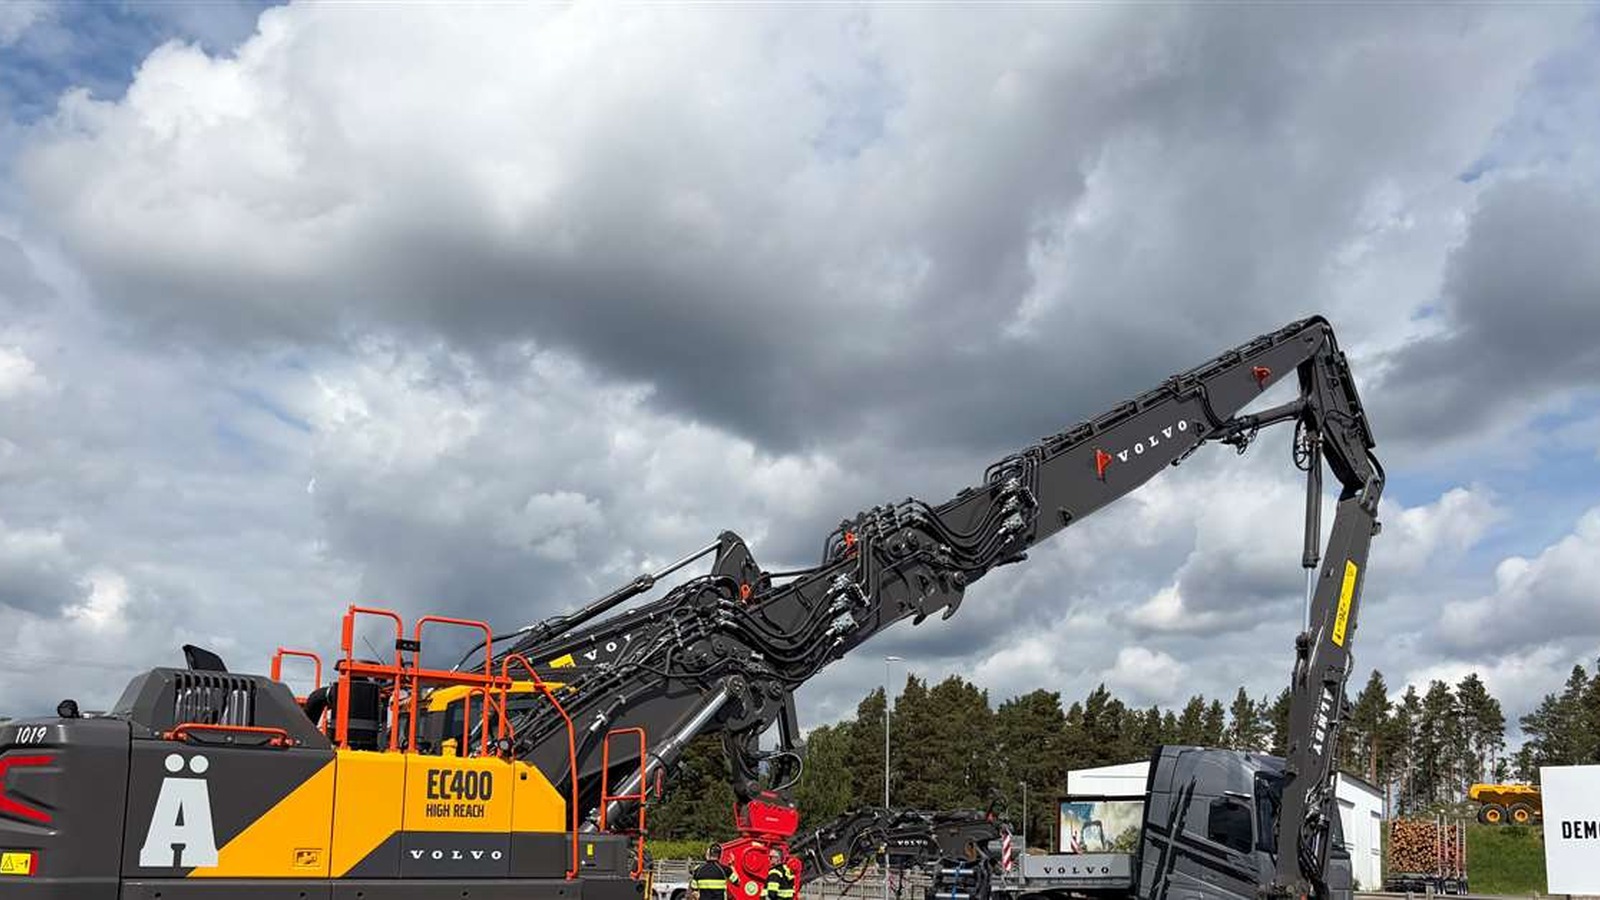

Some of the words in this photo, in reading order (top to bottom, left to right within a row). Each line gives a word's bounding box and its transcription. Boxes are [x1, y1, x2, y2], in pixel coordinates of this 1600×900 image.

[1117, 419, 1189, 463] VOLVO
[15, 724, 47, 744] 1019
[426, 769, 493, 801] EC400
[139, 754, 219, 867] Ä
[426, 804, 450, 817] HIGH
[453, 805, 485, 818] REACH
[1562, 821, 1600, 839] DEM
[409, 849, 504, 861] VOLVO
[1043, 866, 1110, 874] VOLVO
